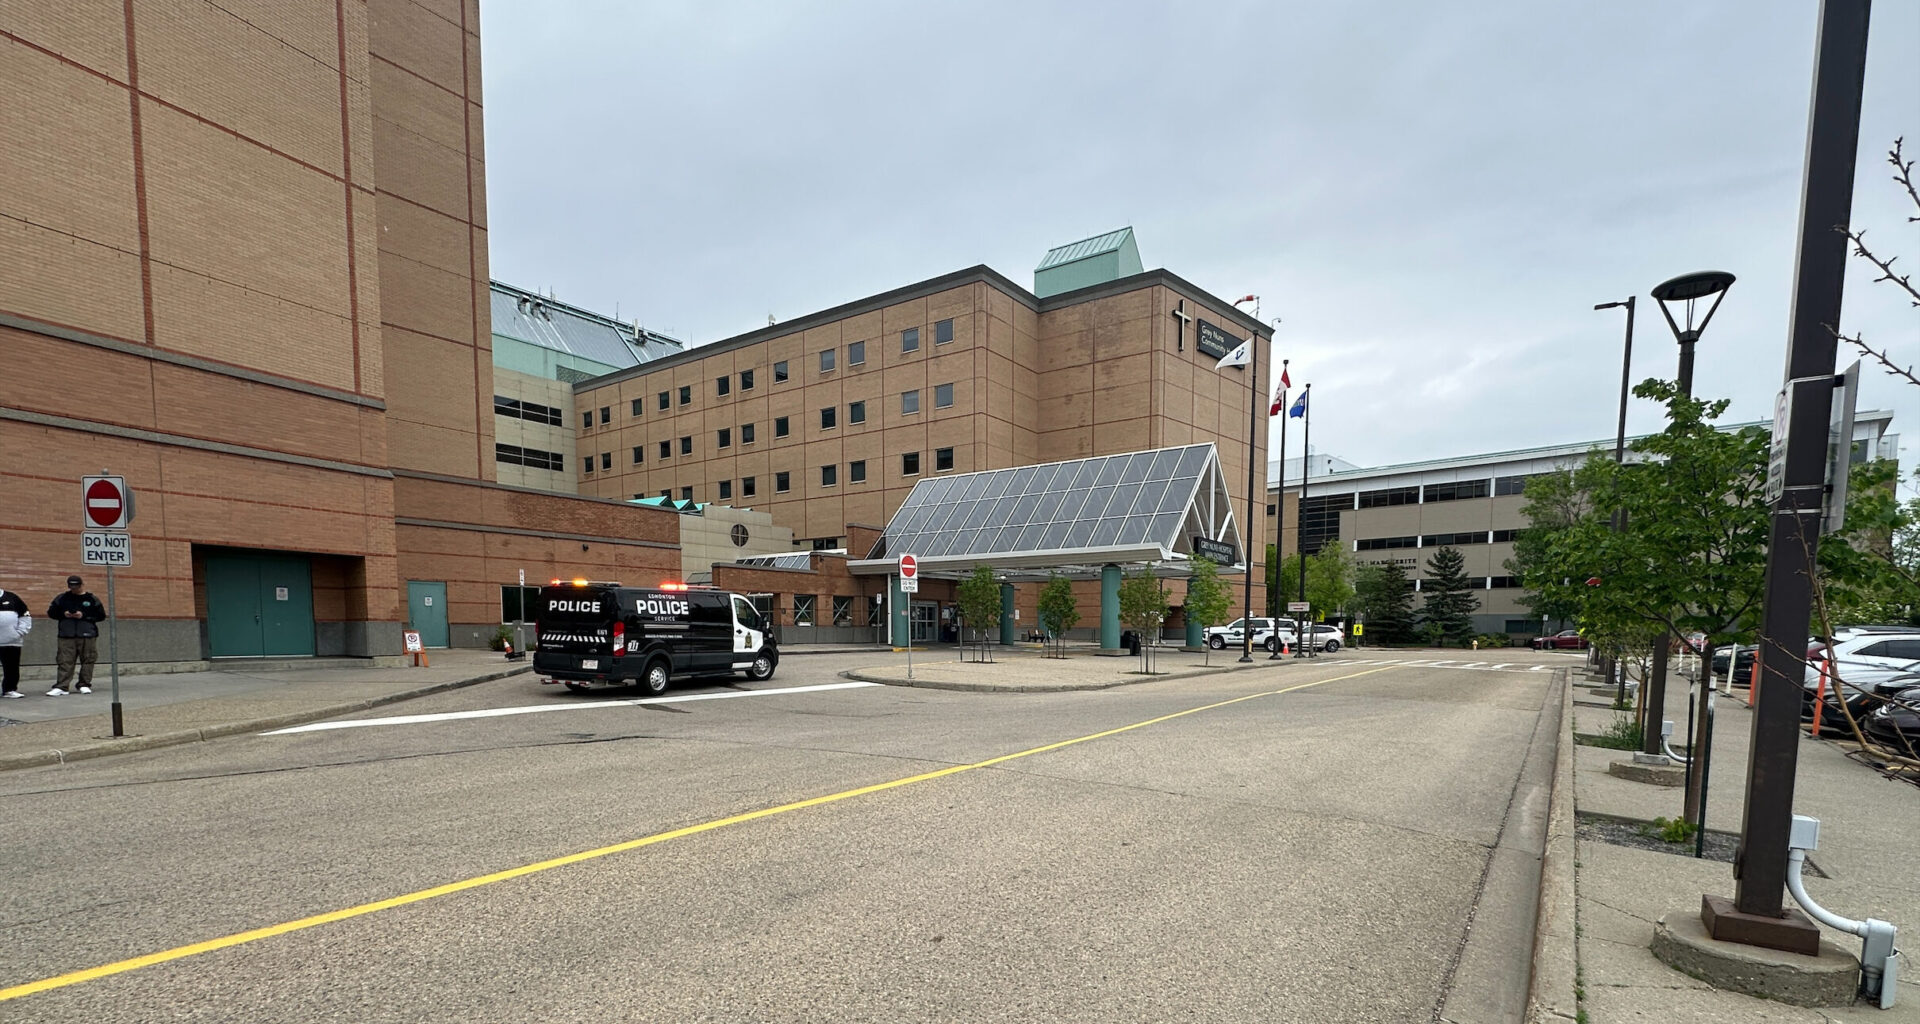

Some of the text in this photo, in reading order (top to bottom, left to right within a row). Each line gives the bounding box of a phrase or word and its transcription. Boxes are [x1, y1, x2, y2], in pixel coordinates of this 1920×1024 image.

[1201, 325, 1224, 343] Grey Nuns
[1201, 335, 1226, 355] Community
[85, 536, 127, 548] DO NOT
[87, 551, 125, 562] ENTER
[549, 600, 601, 613] POLICE
[636, 600, 690, 615] POLICE
